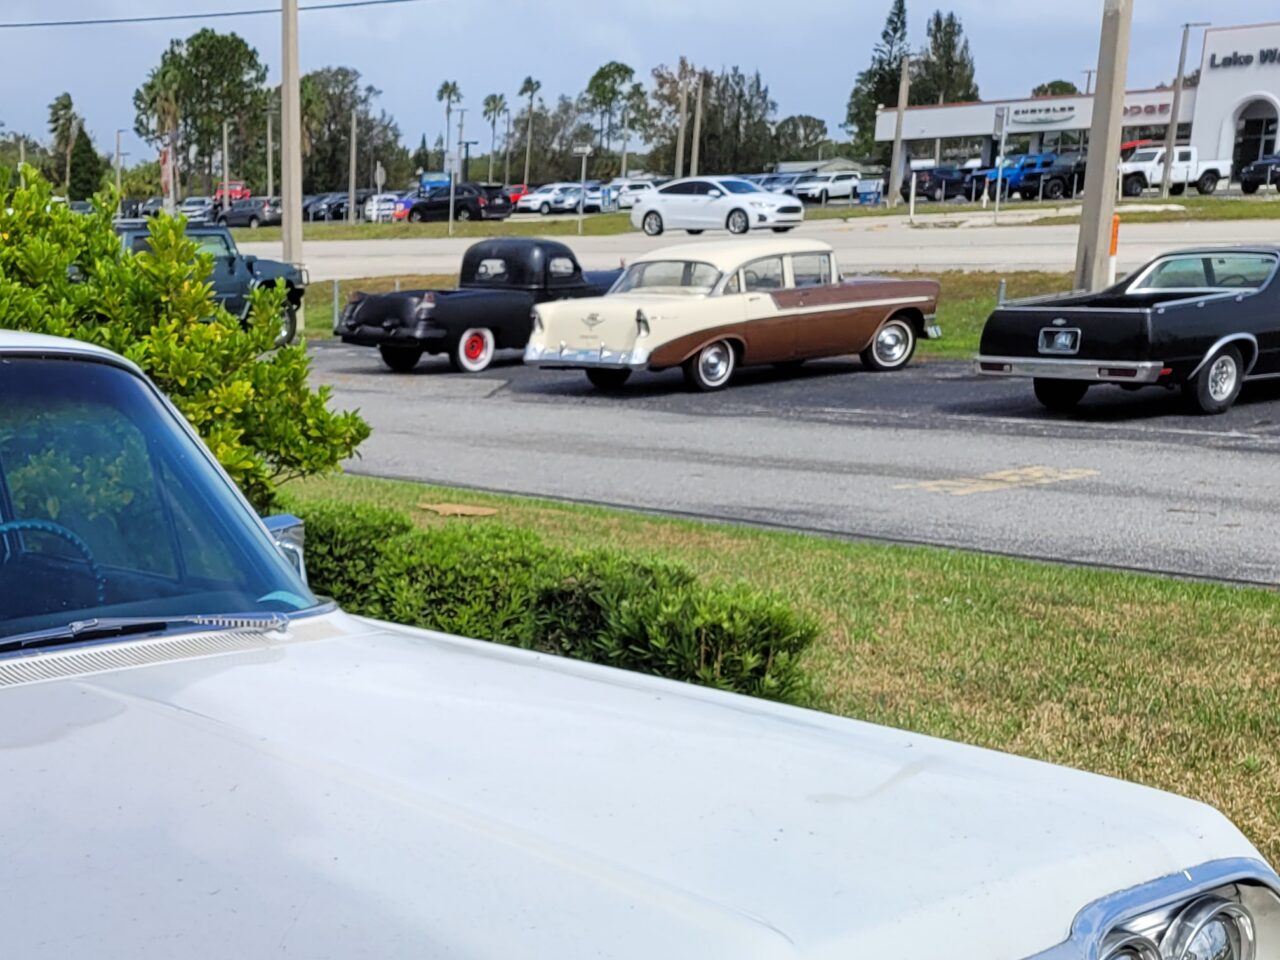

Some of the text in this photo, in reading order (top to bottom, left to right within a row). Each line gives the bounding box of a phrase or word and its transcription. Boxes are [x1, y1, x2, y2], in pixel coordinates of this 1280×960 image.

[1210, 51, 1254, 68] Lake
[1014, 106, 1075, 115] CHRYSLER
[1123, 103, 1170, 116] DGE
